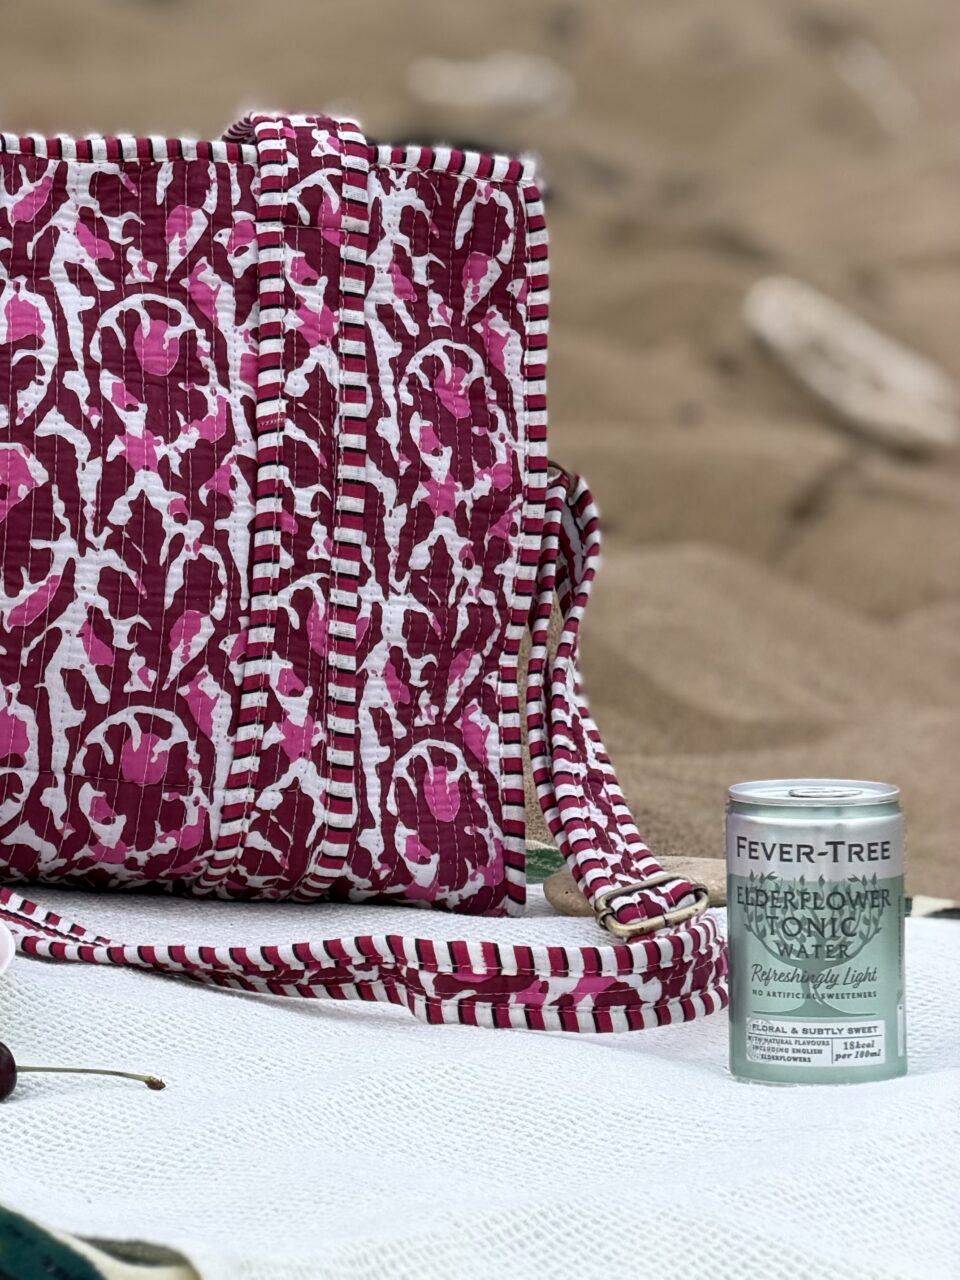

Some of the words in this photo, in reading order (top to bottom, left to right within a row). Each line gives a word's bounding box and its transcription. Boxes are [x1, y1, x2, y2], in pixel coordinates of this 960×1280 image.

[736, 835, 892, 864] FEVER-TREE
[736, 885, 892, 911] ELDERFLOWER
[765, 915, 858, 938] TONIC
[775, 942, 851, 959] WATER
[751, 963, 841, 990] Refreshingly
[842, 966, 878, 989] Light
[752, 989, 763, 997] NO
[766, 990, 817, 1000] ARTIFICIAL
[820, 990, 878, 1000] SWEETENERS
[752, 1023, 788, 1034] FLORAL
[790, 1027, 799, 1035] &
[801, 1027, 845, 1036] SUBTLY
[847, 1025, 879, 1035] SWEET
[763, 1037, 793, 1046] NATURAL
[794, 1039, 830, 1047] FLAVOURS
[752, 1044, 790, 1054] INCLUDING
[792, 1047, 823, 1055] ENGLISH
[834, 1052, 852, 1062] per
[854, 1049, 882, 1060] 100ml
[760, 1053, 812, 1063] ELDERFLOWERS
